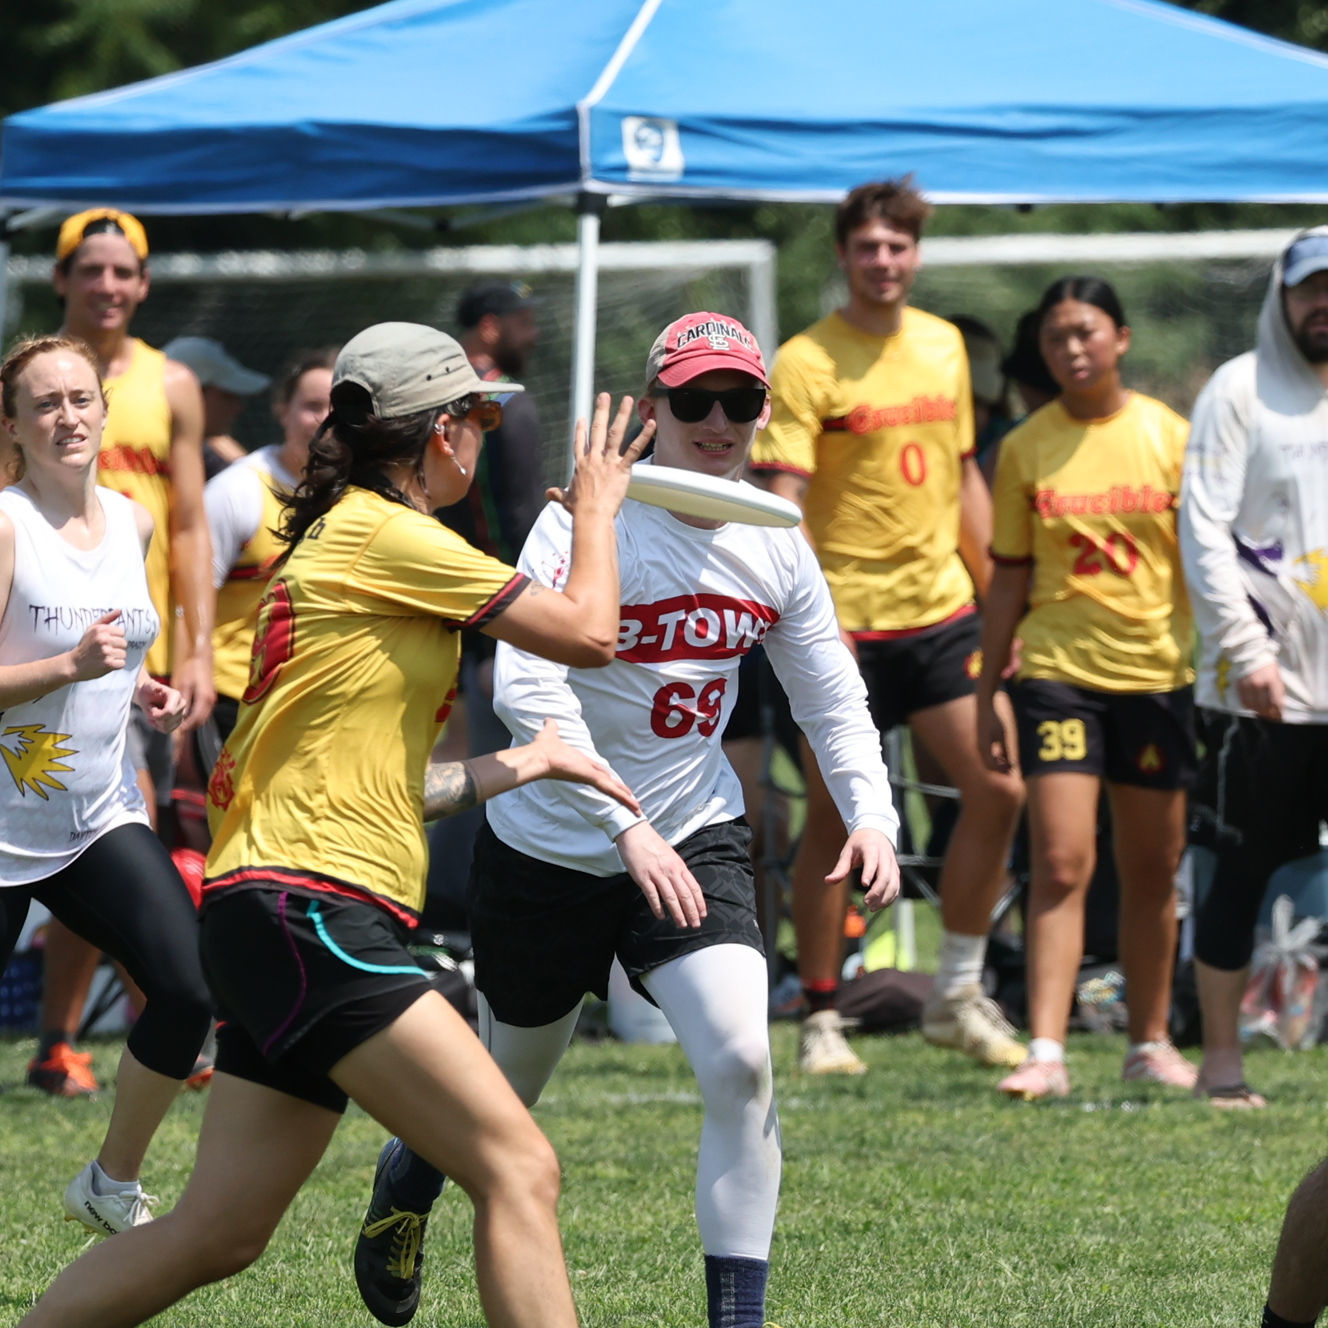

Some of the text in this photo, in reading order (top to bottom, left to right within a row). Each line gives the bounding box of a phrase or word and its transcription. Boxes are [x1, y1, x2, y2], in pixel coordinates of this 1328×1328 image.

[900, 441, 927, 487] 0
[1068, 532, 1139, 576] 20
[650, 677, 728, 739] 69
[1036, 718, 1087, 761] 39
